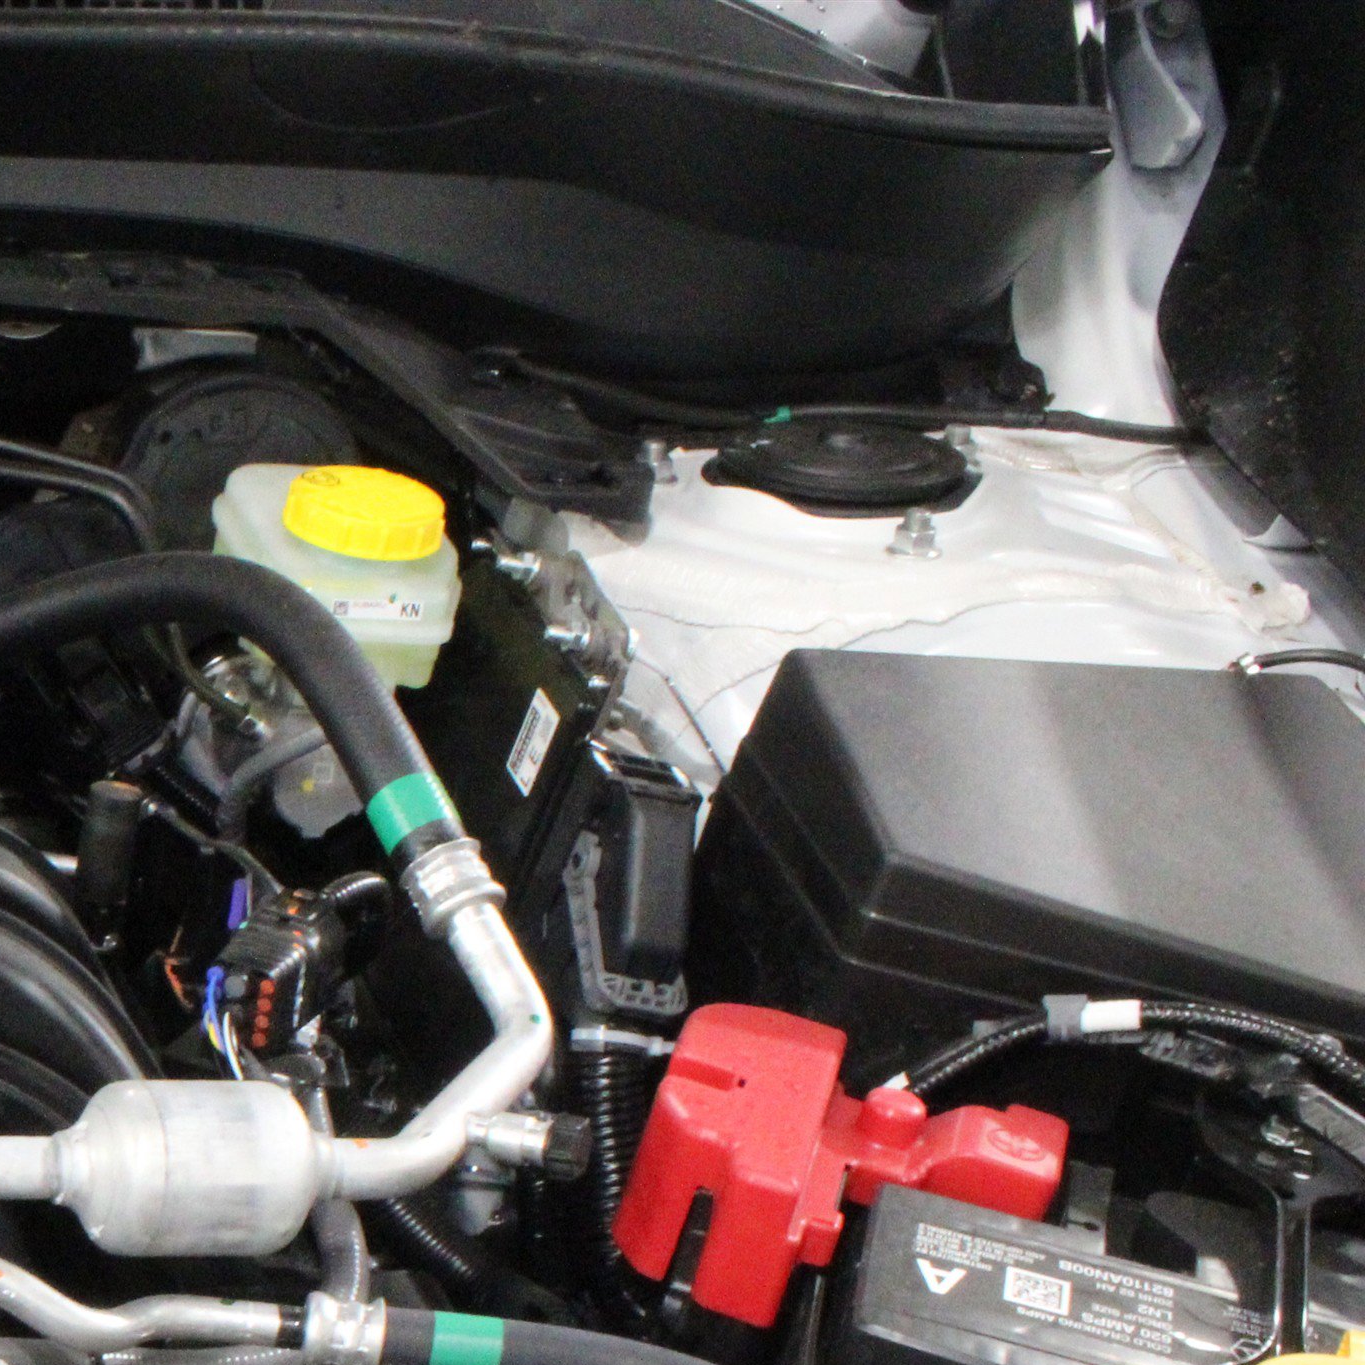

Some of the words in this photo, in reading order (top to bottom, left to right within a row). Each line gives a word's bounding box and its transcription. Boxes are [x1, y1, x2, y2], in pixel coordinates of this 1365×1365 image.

[400, 603, 421, 617] KN
[1095, 1281, 1118, 1293] AH
[1017, 1306, 1056, 1323] AMPS
[1091, 1302, 1121, 1318] SIZE
[1137, 1304, 1173, 1321] LN2
[1058, 1317, 1131, 1343] CRANKING
[1080, 1312, 1137, 1334] AMPS
[1123, 1313, 1173, 1331] GROUP
[1133, 1338, 1172, 1355] COLD
